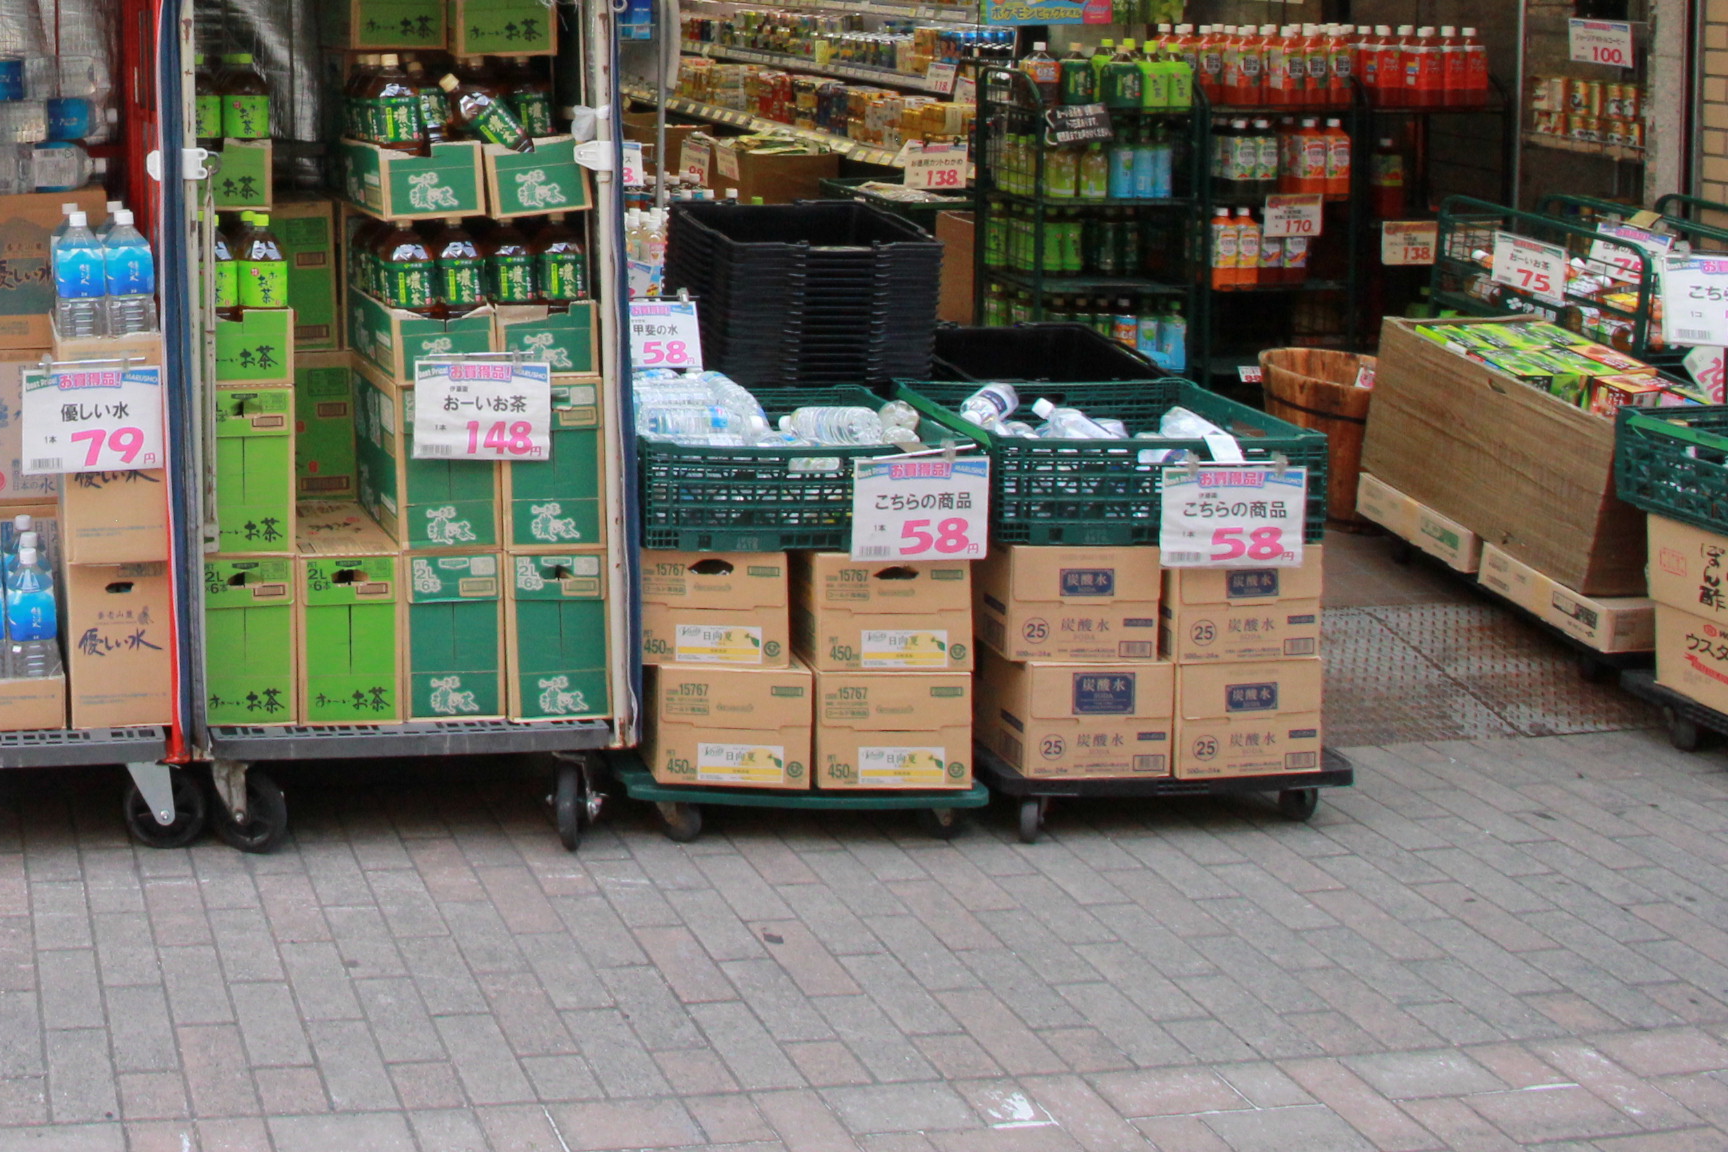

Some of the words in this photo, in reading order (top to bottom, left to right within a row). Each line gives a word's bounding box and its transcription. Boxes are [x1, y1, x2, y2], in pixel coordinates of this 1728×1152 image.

[633, 323, 678, 336] 甲斐の水
[61, 401, 129, 422] 優しい水
[875, 491, 972, 511] こちらの商品
[1183, 499, 1287, 519] こちらの商品
[308, 569, 327, 581] 2L
[415, 568, 436, 580] 2L
[655, 564, 686, 576] 15767
[838, 569, 868, 582] 15767
[1067, 574, 1108, 587] 炭酸水
[1232, 575, 1271, 587] 炭酸水
[1026, 623, 1045, 638] 25
[1061, 618, 1109, 633] 炭酸水
[1228, 619, 1275, 632] 炭酸水
[703, 630, 732, 642] 日向夏
[1194, 625, 1214, 640] 25
[79, 627, 162, 656] 優しい水
[888, 634, 919, 647] 日向夏
[679, 684, 709, 696] 15767
[1082, 678, 1125, 691] 炭酸水
[838, 687, 867, 699] 15767
[1232, 688, 1270, 700] 炭酸水
[1077, 734, 1124, 747] 炭酸水
[1229, 733, 1276, 746] 炭酸水
[1043, 740, 1062, 755] 25
[1196, 741, 1215, 755] 25
[725, 750, 756, 762] 日向夏
[886, 752, 918, 765] 日向夏
